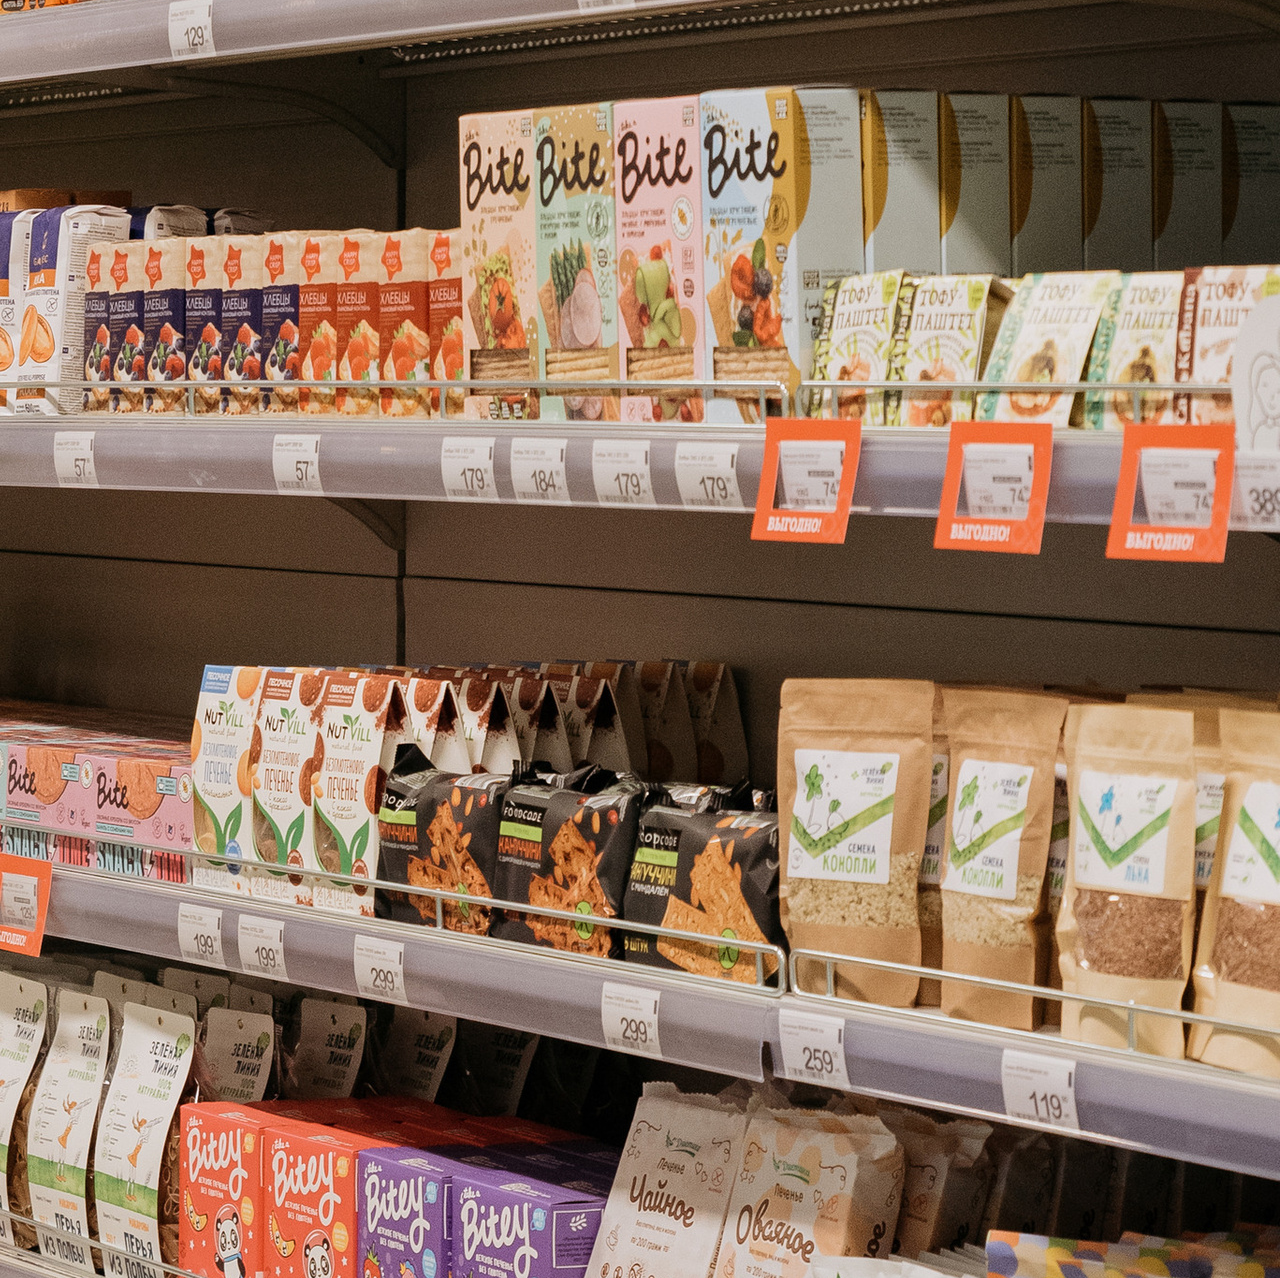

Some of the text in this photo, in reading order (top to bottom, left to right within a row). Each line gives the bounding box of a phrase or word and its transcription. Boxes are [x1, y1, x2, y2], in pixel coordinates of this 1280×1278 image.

[462, 140, 531, 212] Bite
[536, 134, 607, 207] Bite
[618, 130, 693, 204] Bite
[704, 123, 788, 199] Bite
[767, 515, 822, 534] ВЫГОДНО!
[950, 523, 1010, 542] ВЫГОДНО!
[1125, 531, 1194, 552] ВЫГОДНО!
[7, 758, 37, 801] Bite
[822, 852, 877, 875] КОНОПЛИ
[961, 866, 1004, 890] КОНОПЛИ
[187, 1127, 248, 1201] Bitey
[272, 1150, 342, 1226] Bitey
[365, 1174, 430, 1254] Bitey
[630, 1174, 695, 1228] Чайное
[736, 1198, 815, 1264] Овсяное
